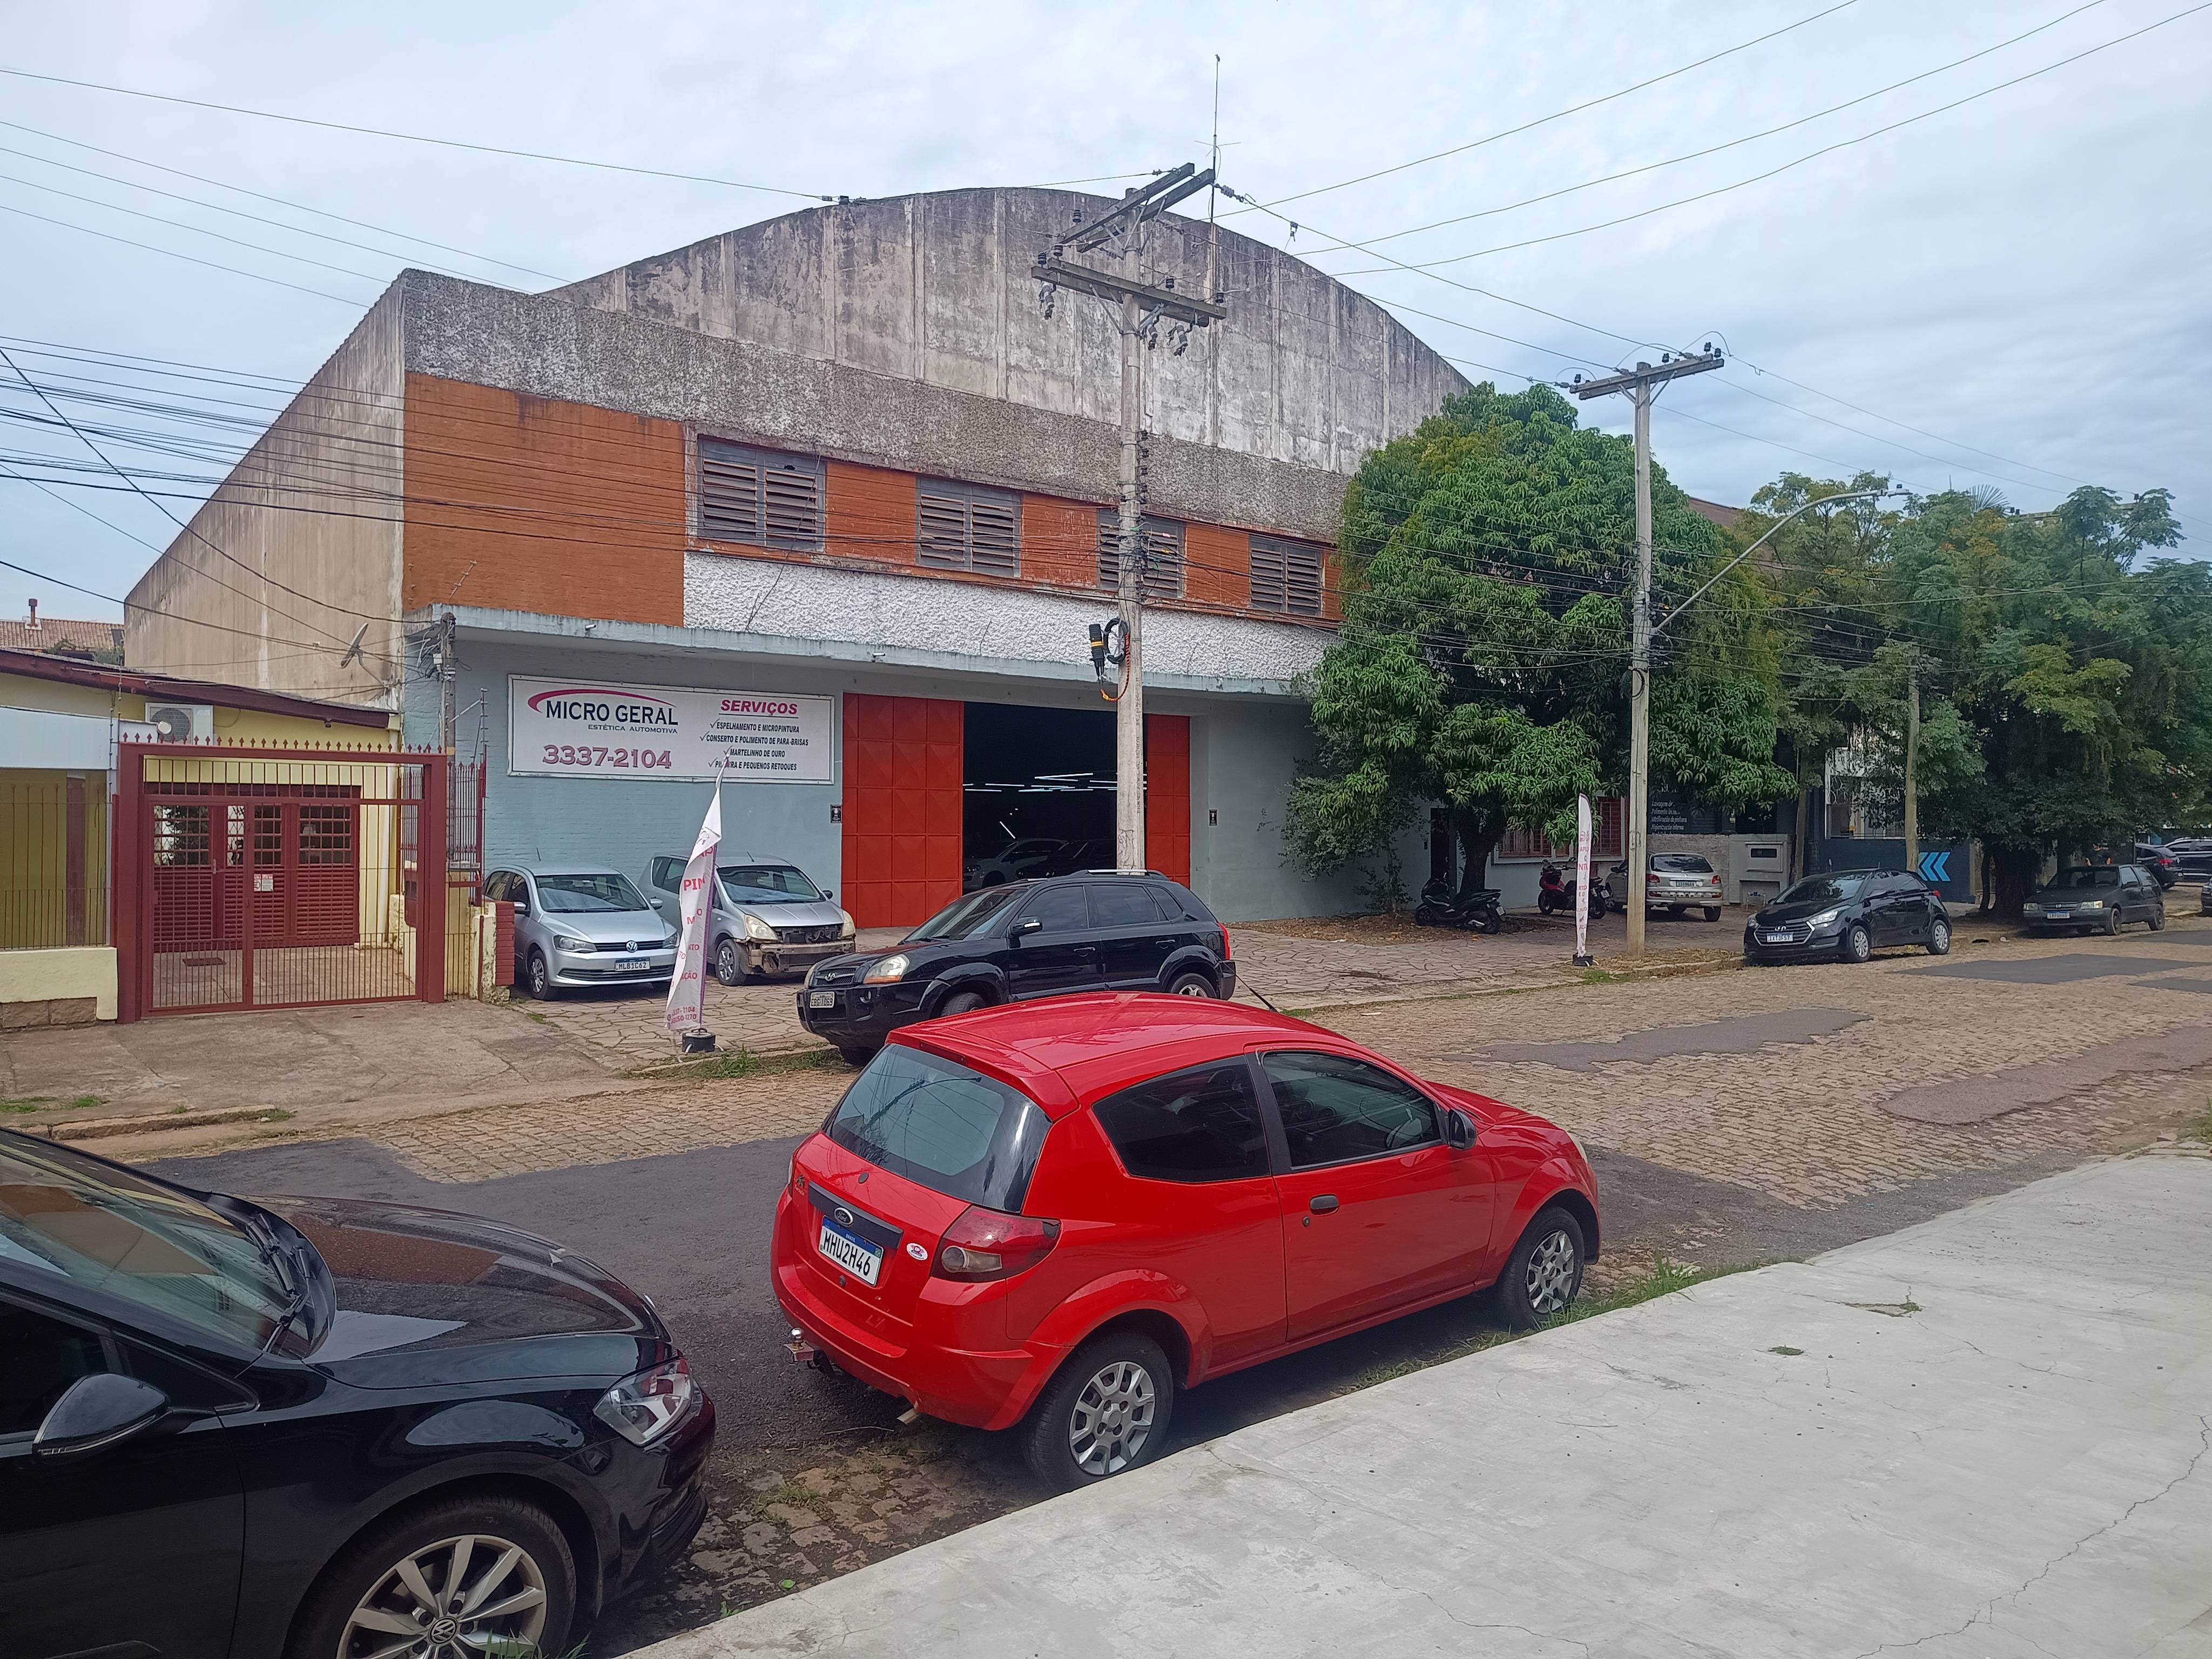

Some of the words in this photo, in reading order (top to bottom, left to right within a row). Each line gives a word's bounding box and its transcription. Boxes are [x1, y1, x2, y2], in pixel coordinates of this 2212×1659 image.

[546, 700, 610, 721] MICRO
[615, 705, 678, 726] GERAL
[720, 699, 798, 716] SERVIÇOS
[629, 726, 678, 734] AUTOMOTIVA
[717, 721, 757, 731] ESPELHAMENTO
[762, 724, 799, 733] MICROPINTURA
[706, 734, 733, 743] CONSERTO
[739, 736, 768, 744] POLIMENTO
[777, 738, 808, 746] PARA-BRISAS
[542, 744, 672, 769] 3337-2104
[730, 748, 762, 757] MARTELINHO
[715, 760, 737, 768] PIRA
[743, 761, 770, 770] PEQUENOS
[771, 763, 797, 771] RETOQUES
[618, 962, 646, 970] MLB1C62
[823, 1230, 871, 1276] MHU2H46
